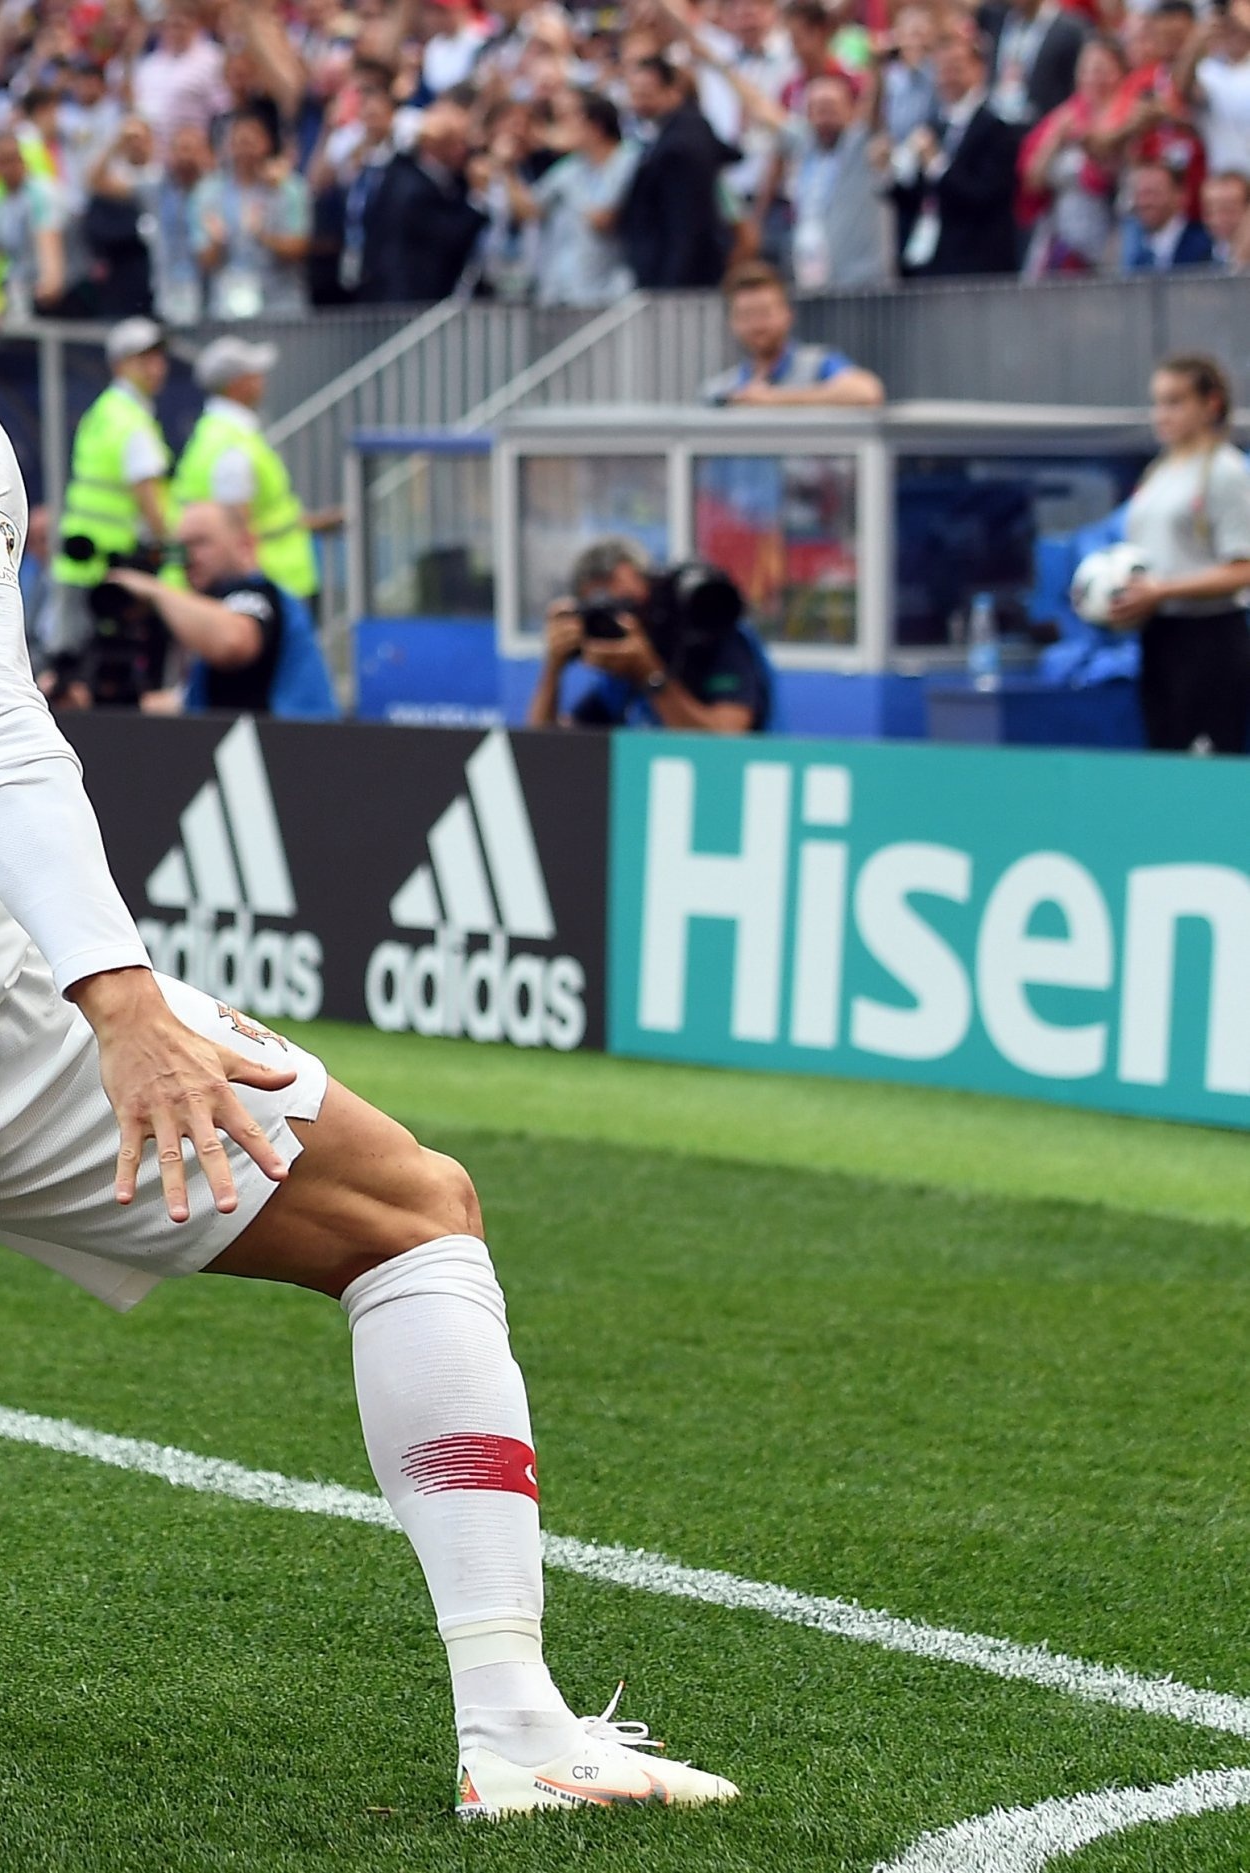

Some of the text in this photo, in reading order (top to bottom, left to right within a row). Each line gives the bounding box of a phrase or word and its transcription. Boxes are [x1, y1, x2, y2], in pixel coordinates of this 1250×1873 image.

[365, 918, 587, 1051] adidas
[637, 756, 1250, 1097] Hisen
[572, 1765, 599, 1780] CR7
